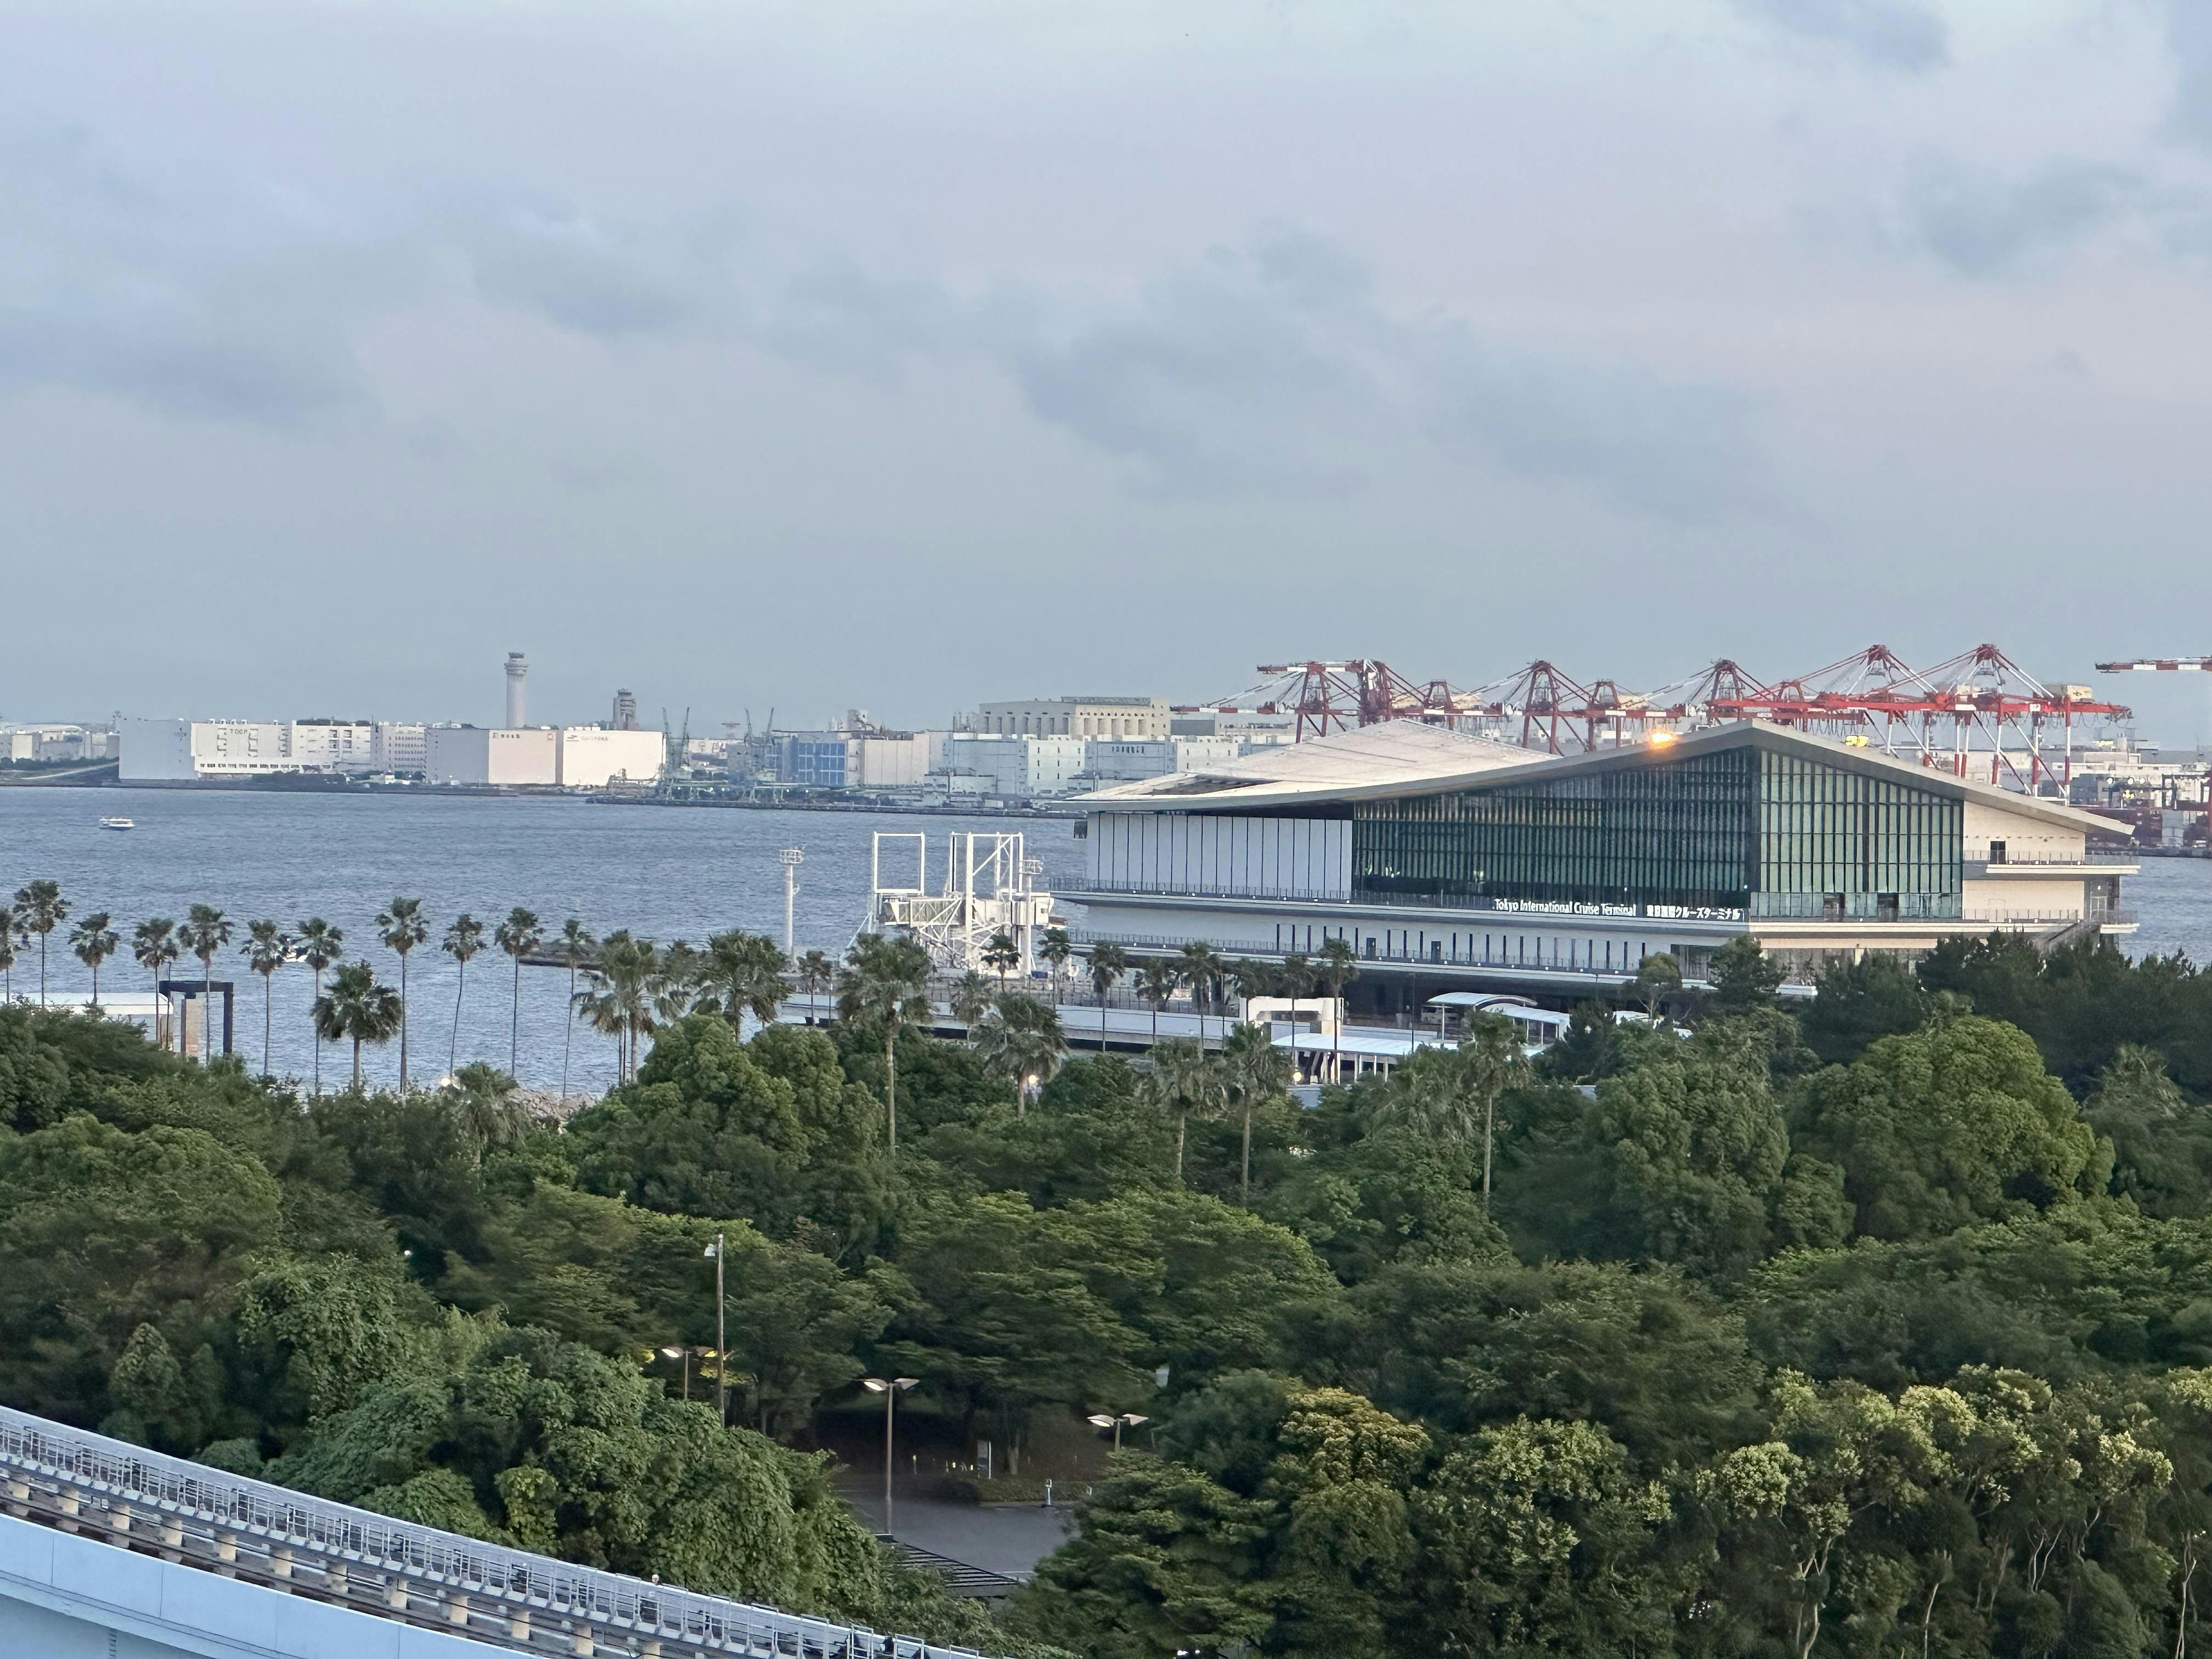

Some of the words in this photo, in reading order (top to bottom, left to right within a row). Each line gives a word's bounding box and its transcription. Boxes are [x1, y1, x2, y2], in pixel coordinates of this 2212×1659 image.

[1494, 898, 1519, 912] Tokyo
[1520, 899, 1573, 913] International
[1573, 902, 1600, 915] Cruise
[1601, 903, 1637, 917] Terminal
